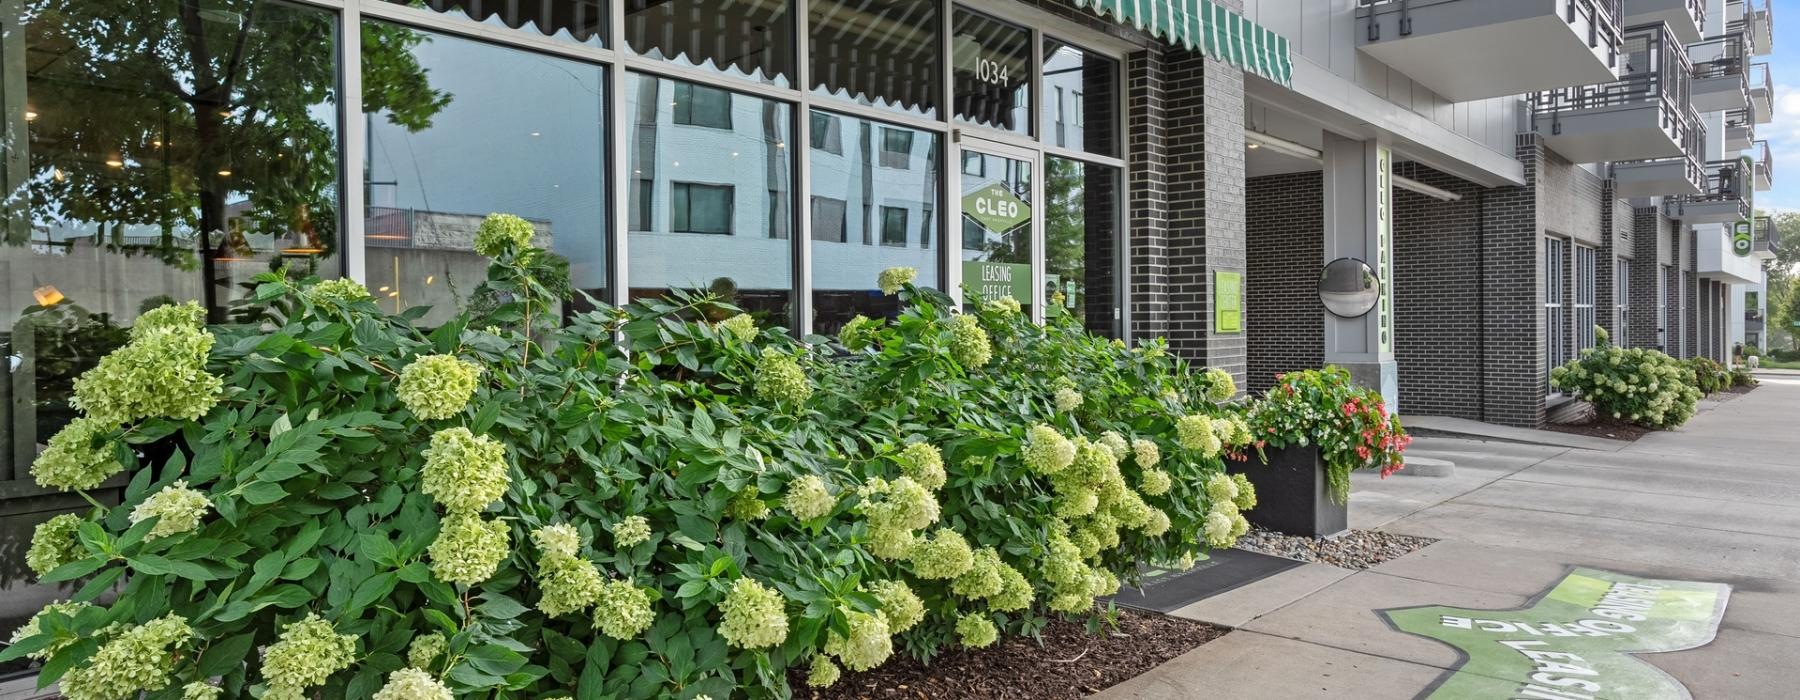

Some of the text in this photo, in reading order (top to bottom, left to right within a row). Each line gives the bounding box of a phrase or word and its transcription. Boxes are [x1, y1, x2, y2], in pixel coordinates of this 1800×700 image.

[976, 57, 1008, 87] 1034
[991, 188, 1003, 197] THE
[976, 197, 1018, 218] CLEO
[982, 265, 1012, 281] LEASING
[1440, 615, 1637, 637] OFFICE
